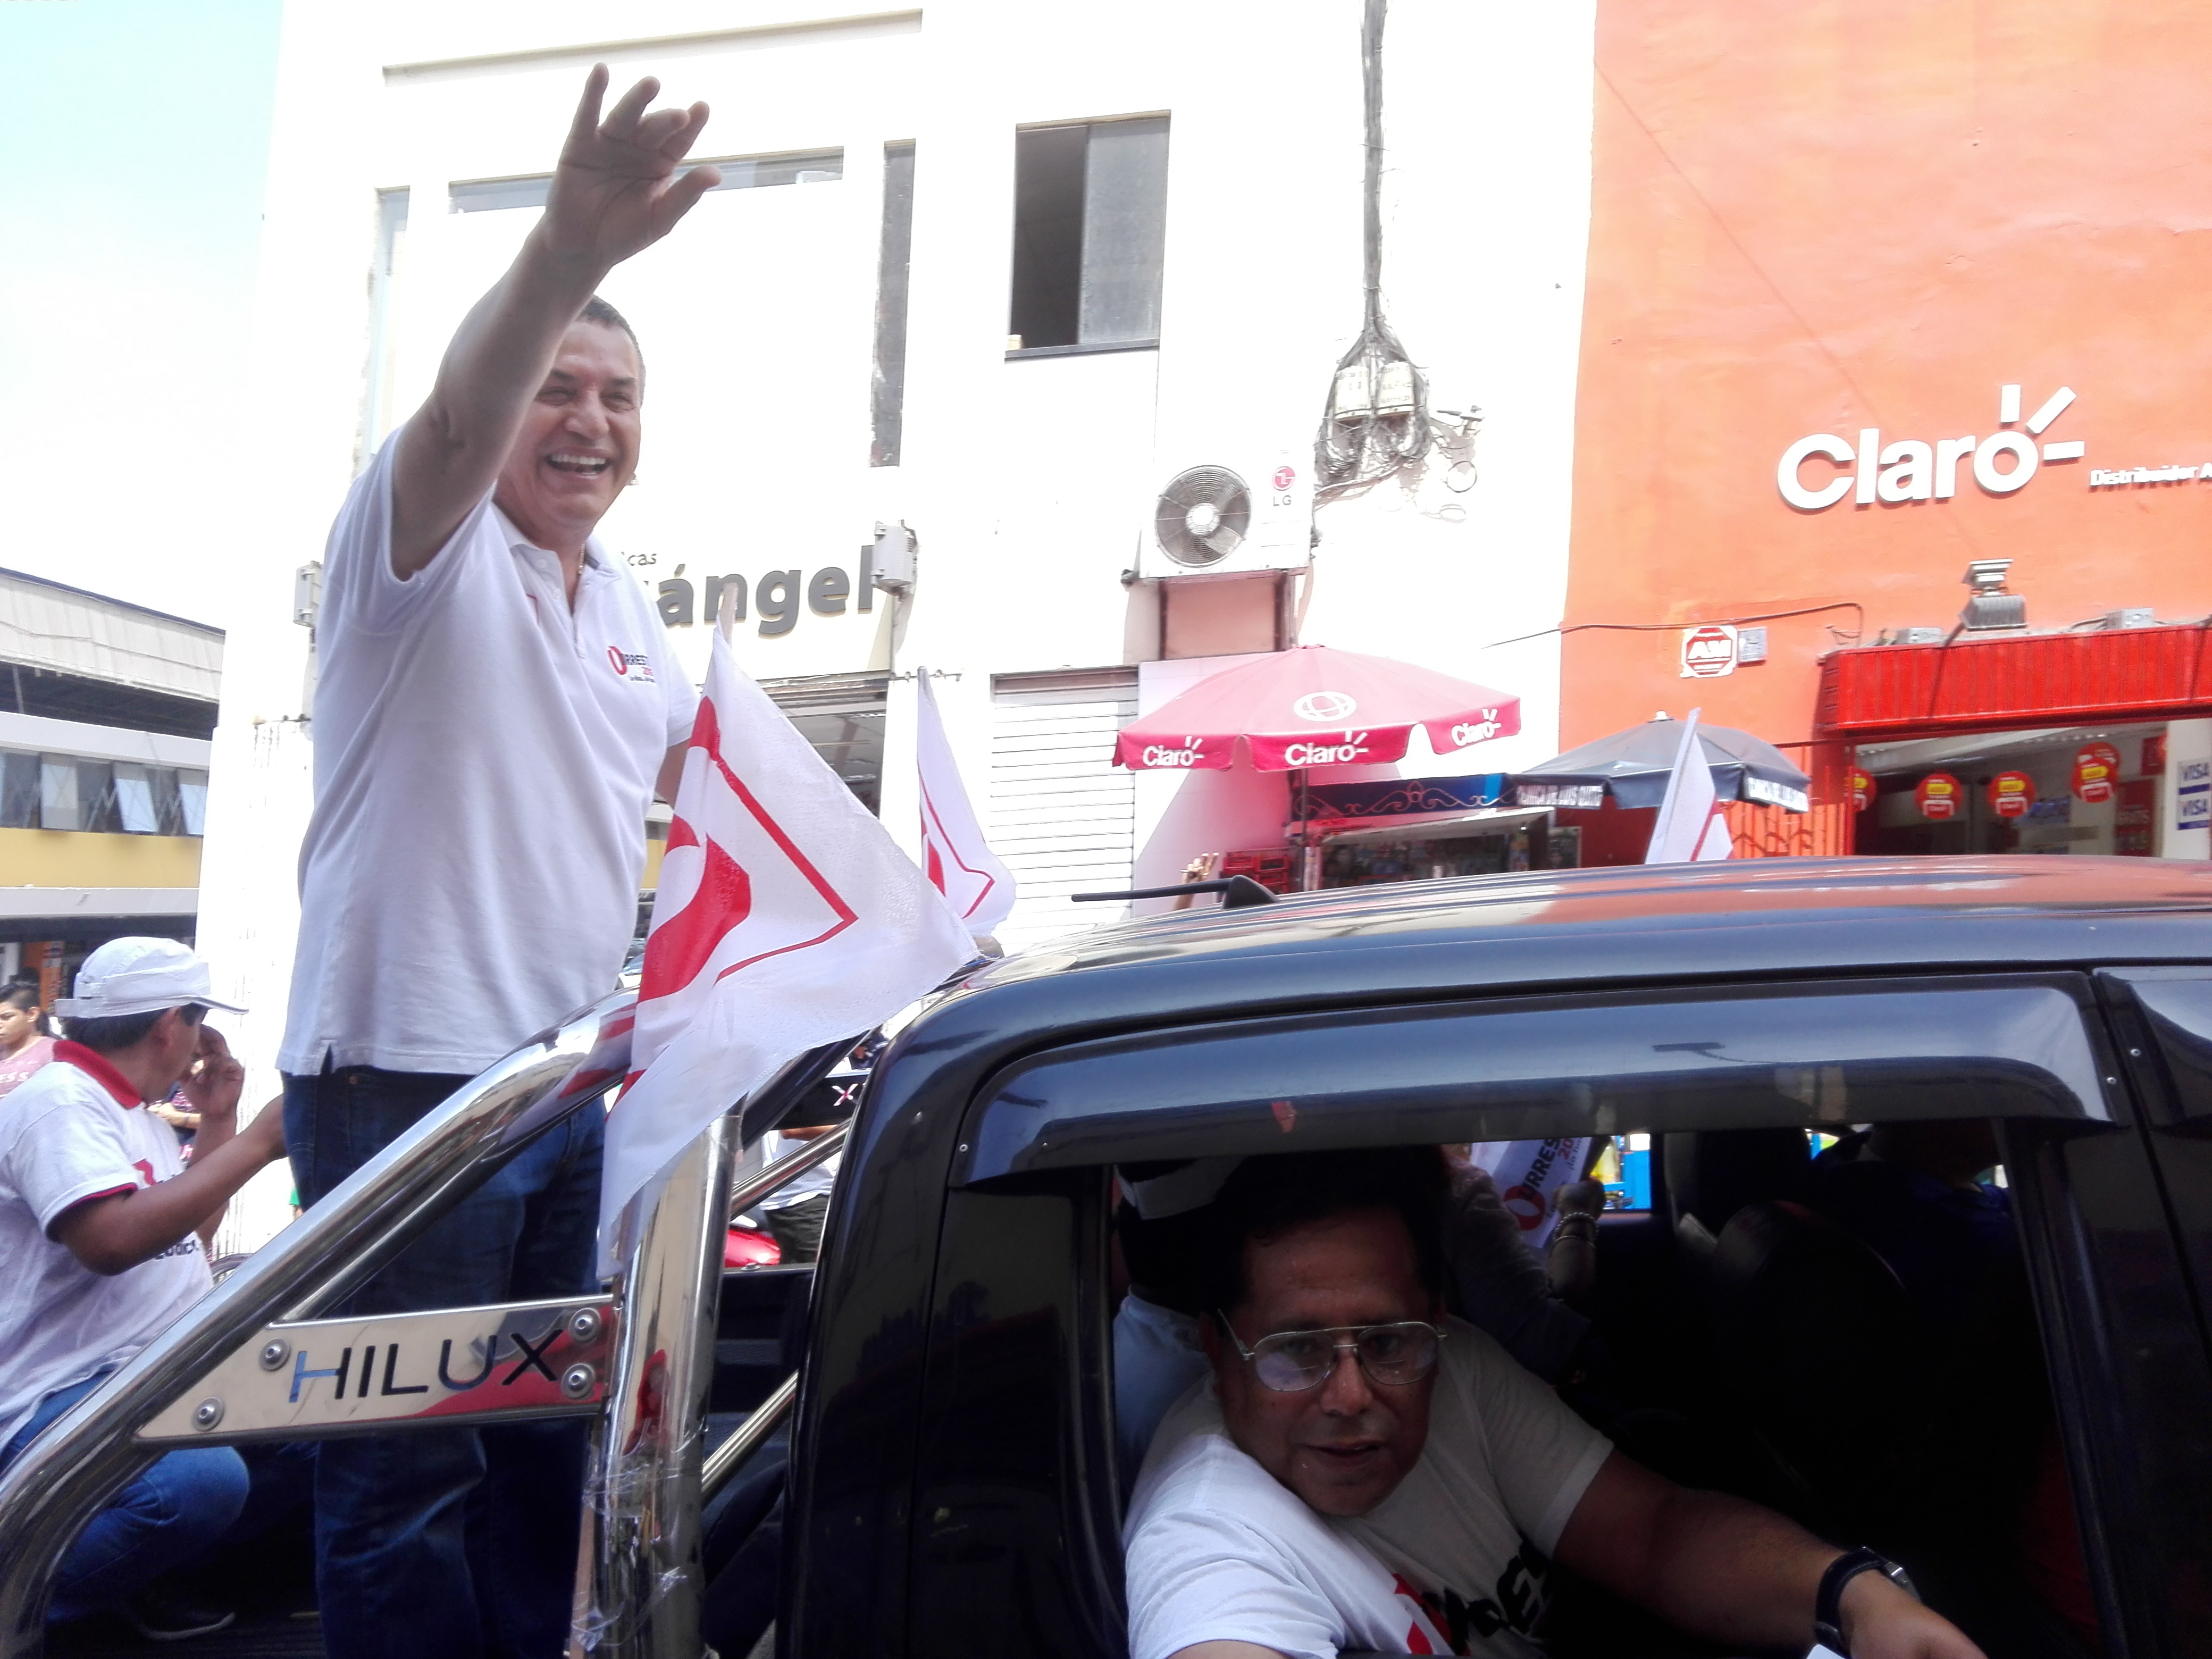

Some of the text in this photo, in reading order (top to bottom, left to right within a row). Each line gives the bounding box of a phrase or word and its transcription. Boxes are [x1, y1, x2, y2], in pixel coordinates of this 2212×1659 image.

[1777, 426, 2039, 510] Claro
[1272, 495, 1292, 507] LG
[1450, 720, 1496, 747] Claro
[1142, 744, 1195, 767] Claro
[1284, 742, 1356, 766] Claro
[287, 1328, 564, 1404] HILUX
